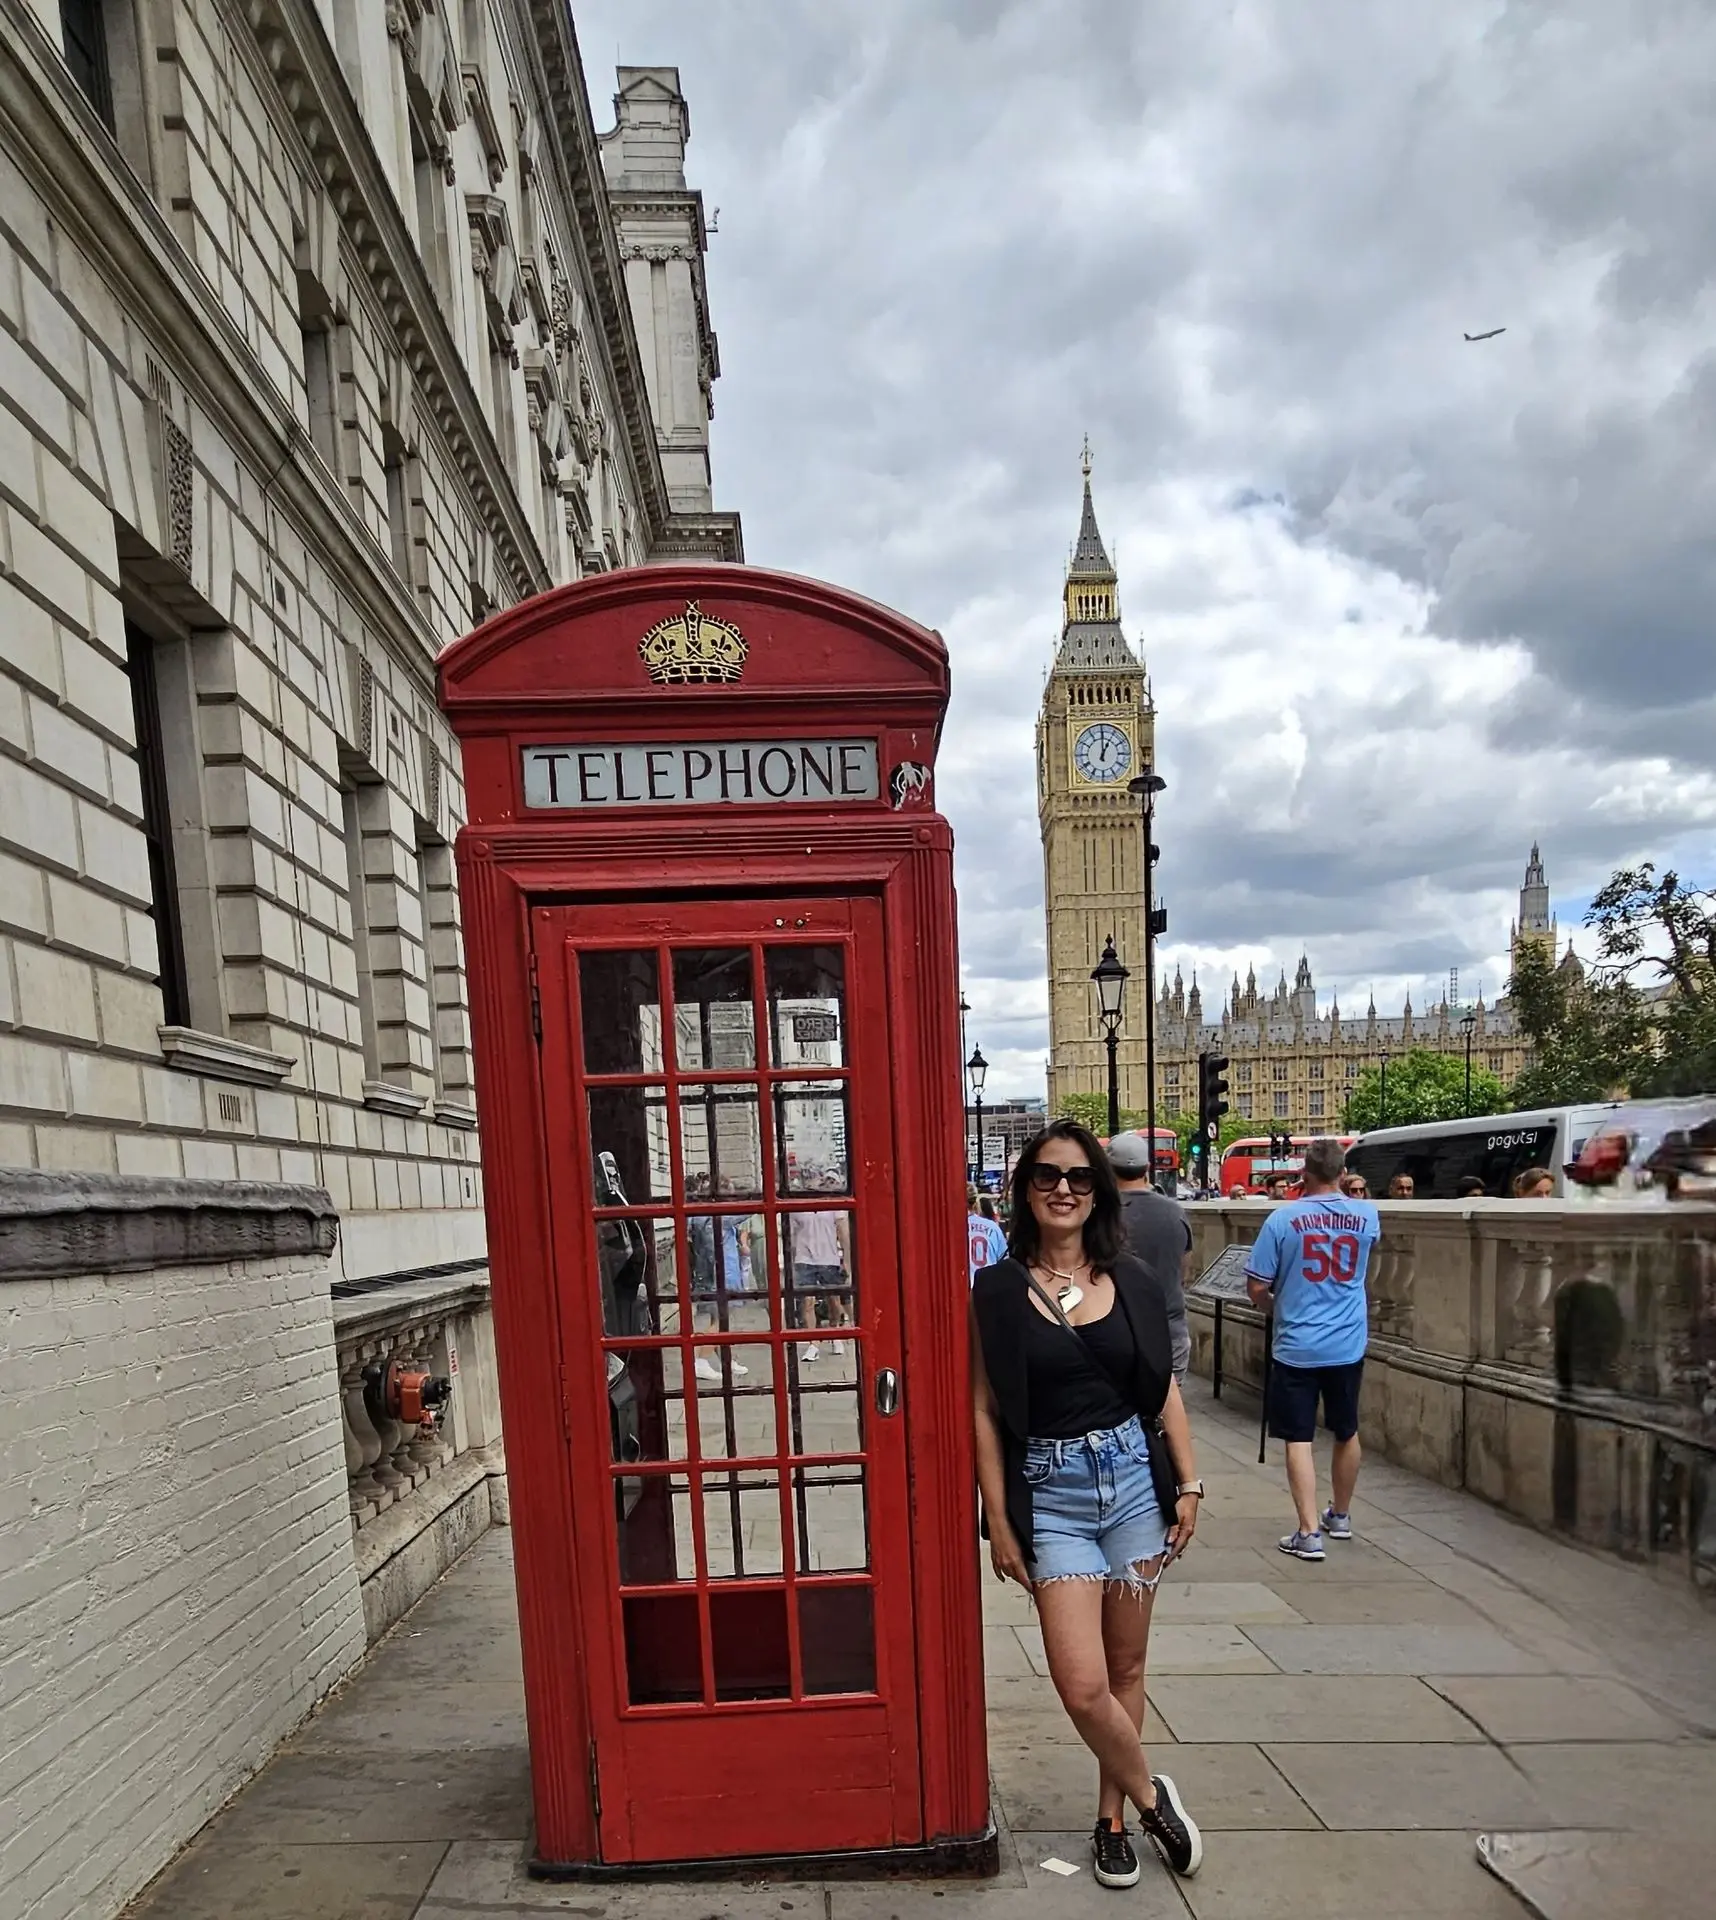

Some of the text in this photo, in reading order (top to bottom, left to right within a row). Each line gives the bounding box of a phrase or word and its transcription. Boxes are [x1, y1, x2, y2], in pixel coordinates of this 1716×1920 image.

[533, 746, 868, 803] TELEPHONE
[1289, 1212, 1368, 1234] WAINWRIGHT
[1301, 1234, 1359, 1283] 50
